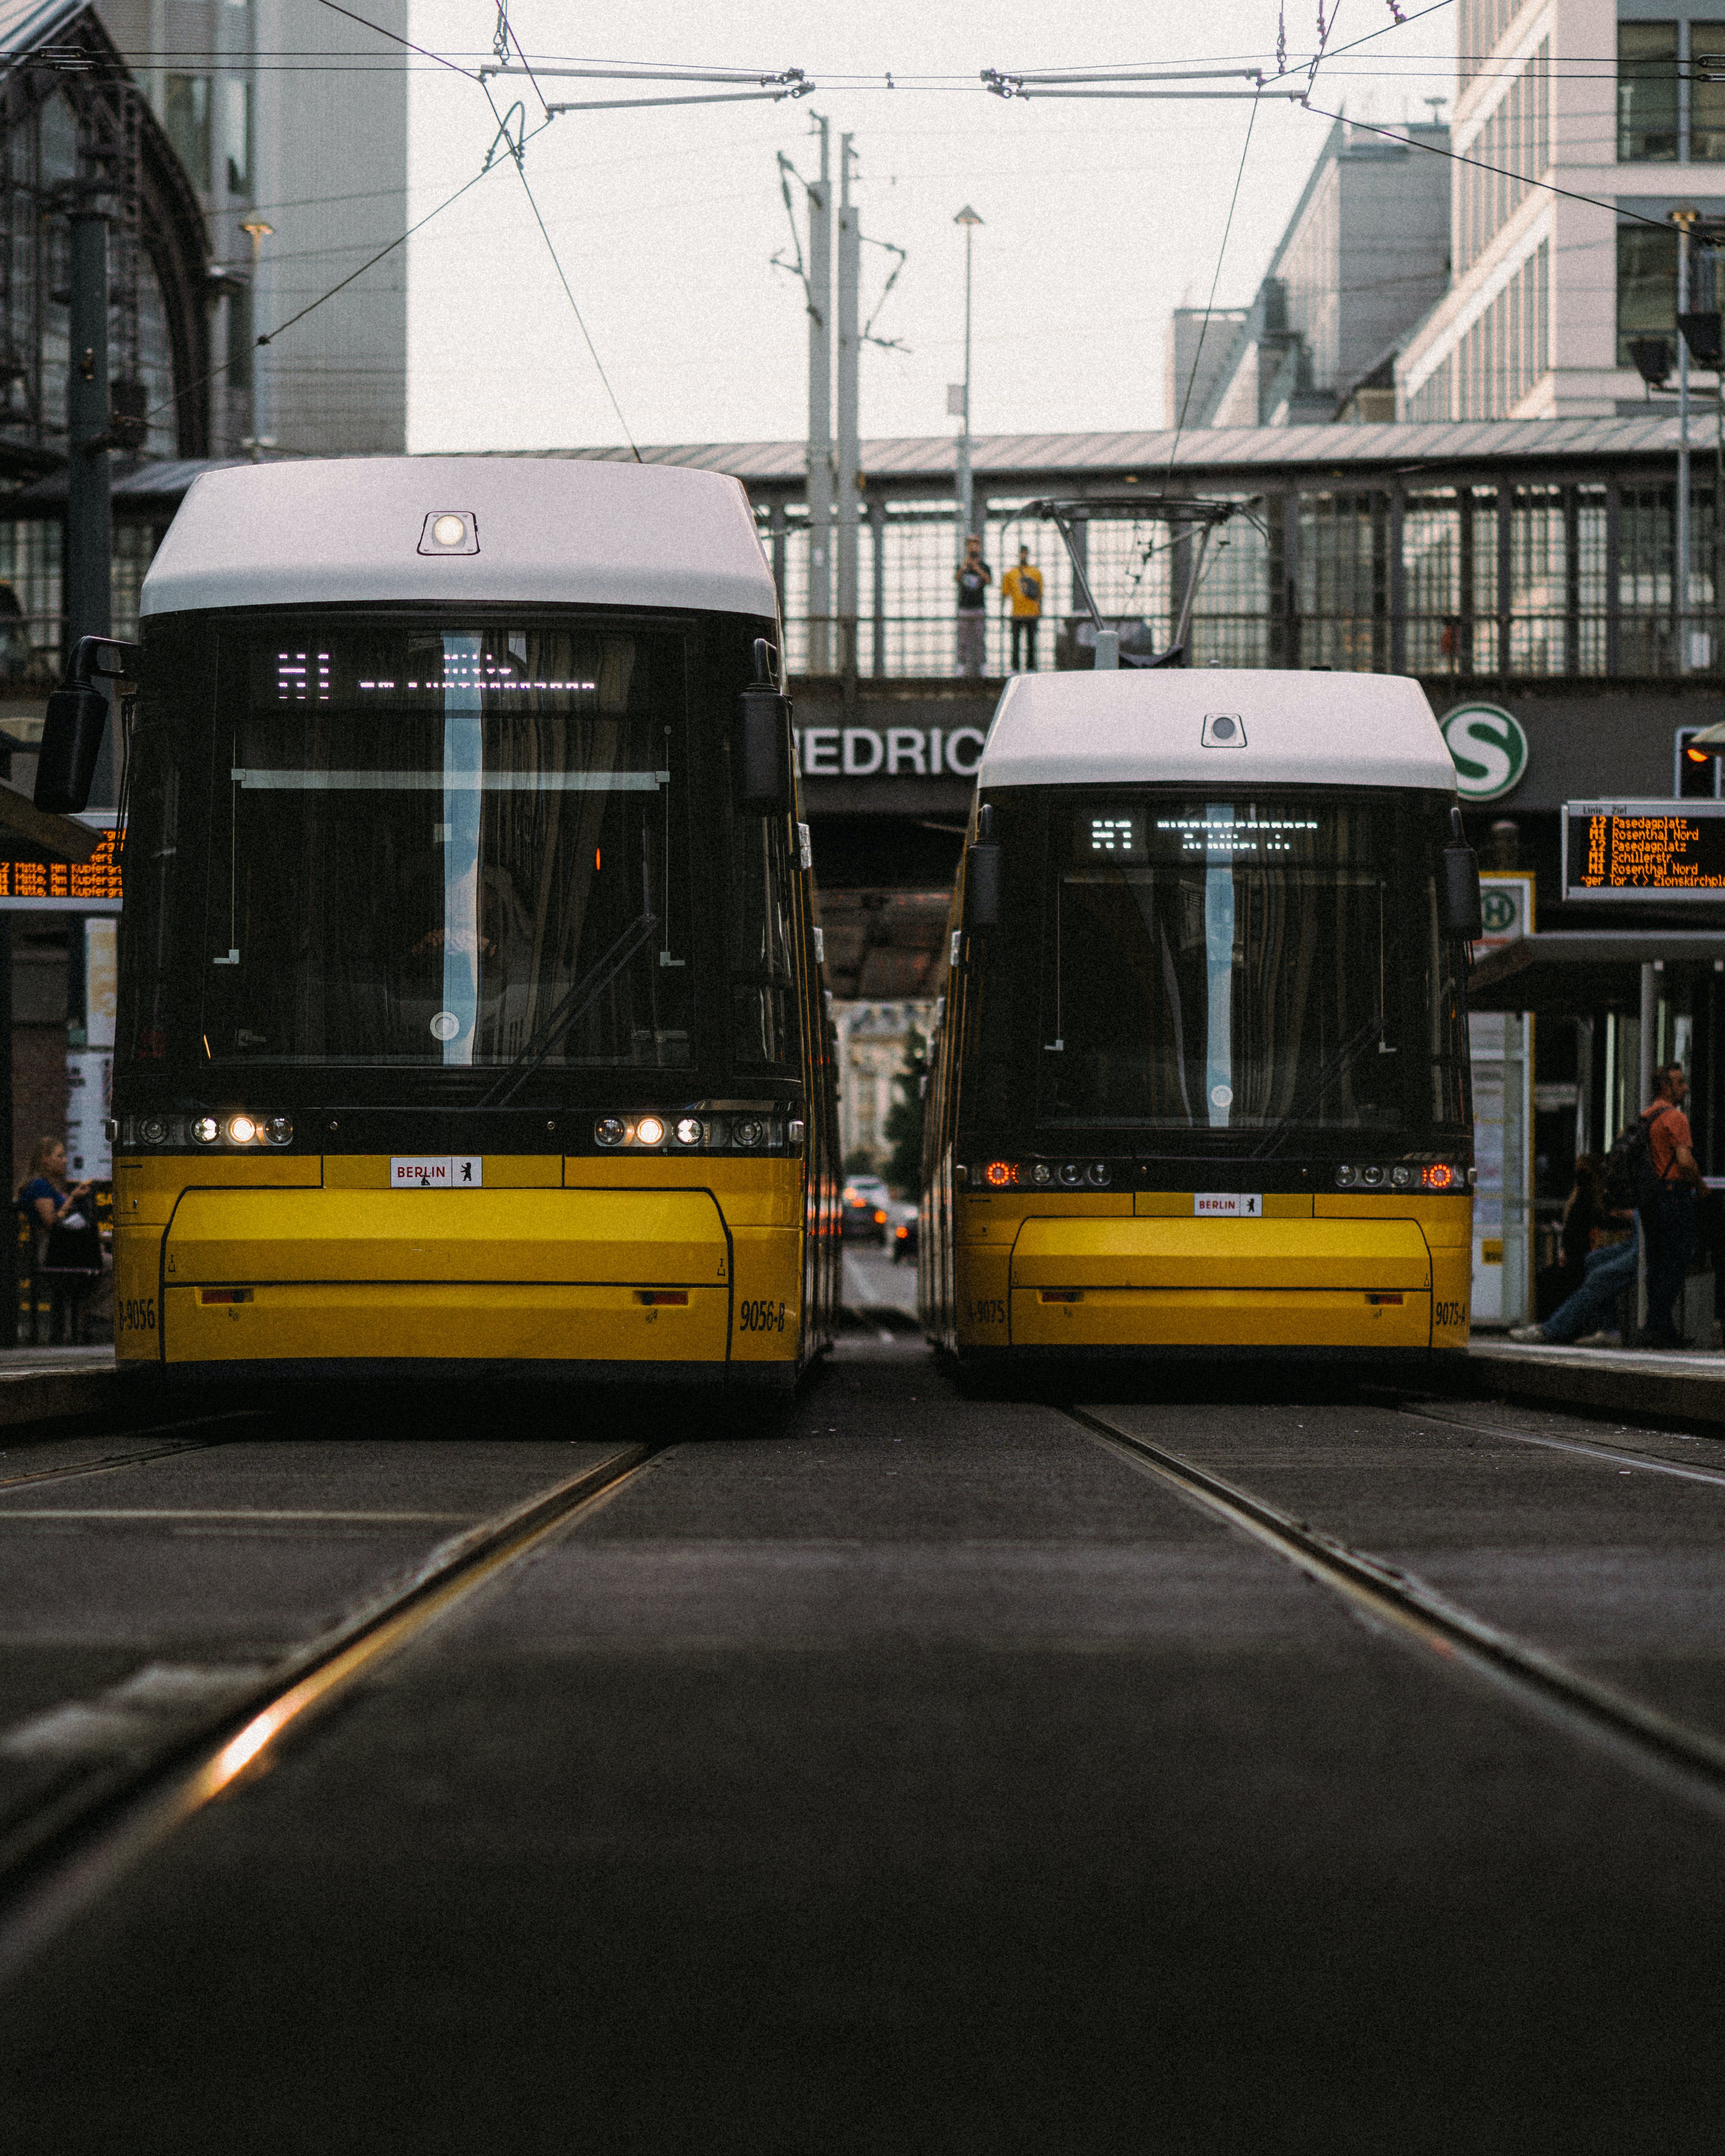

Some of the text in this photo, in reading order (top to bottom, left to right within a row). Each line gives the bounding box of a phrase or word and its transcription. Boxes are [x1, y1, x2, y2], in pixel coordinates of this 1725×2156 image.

[1447, 712, 1510, 791] S
[1583, 806, 1627, 815] Linie Ziel
[1590, 816, 1687, 830] 12 Pasedagplatz
[1590, 827, 1699, 840] M1 Rosenthal Nord
[1590, 840, 1686, 853] 12 Pasedagplatz
[1589, 851, 1673, 863] M1 Schillerstr.
[1588, 862, 1698, 875] M1 Rosenthal Nord
[1609, 874, 1627, 886] Tor
[397, 1166, 445, 1178] BERLIN
[1199, 1200, 1235, 1209] BERLIN
[119, 1298, 155, 1331] B-9056
[740, 1300, 785, 1332] 9056-B
[1436, 1302, 1465, 1327] 9075-A
